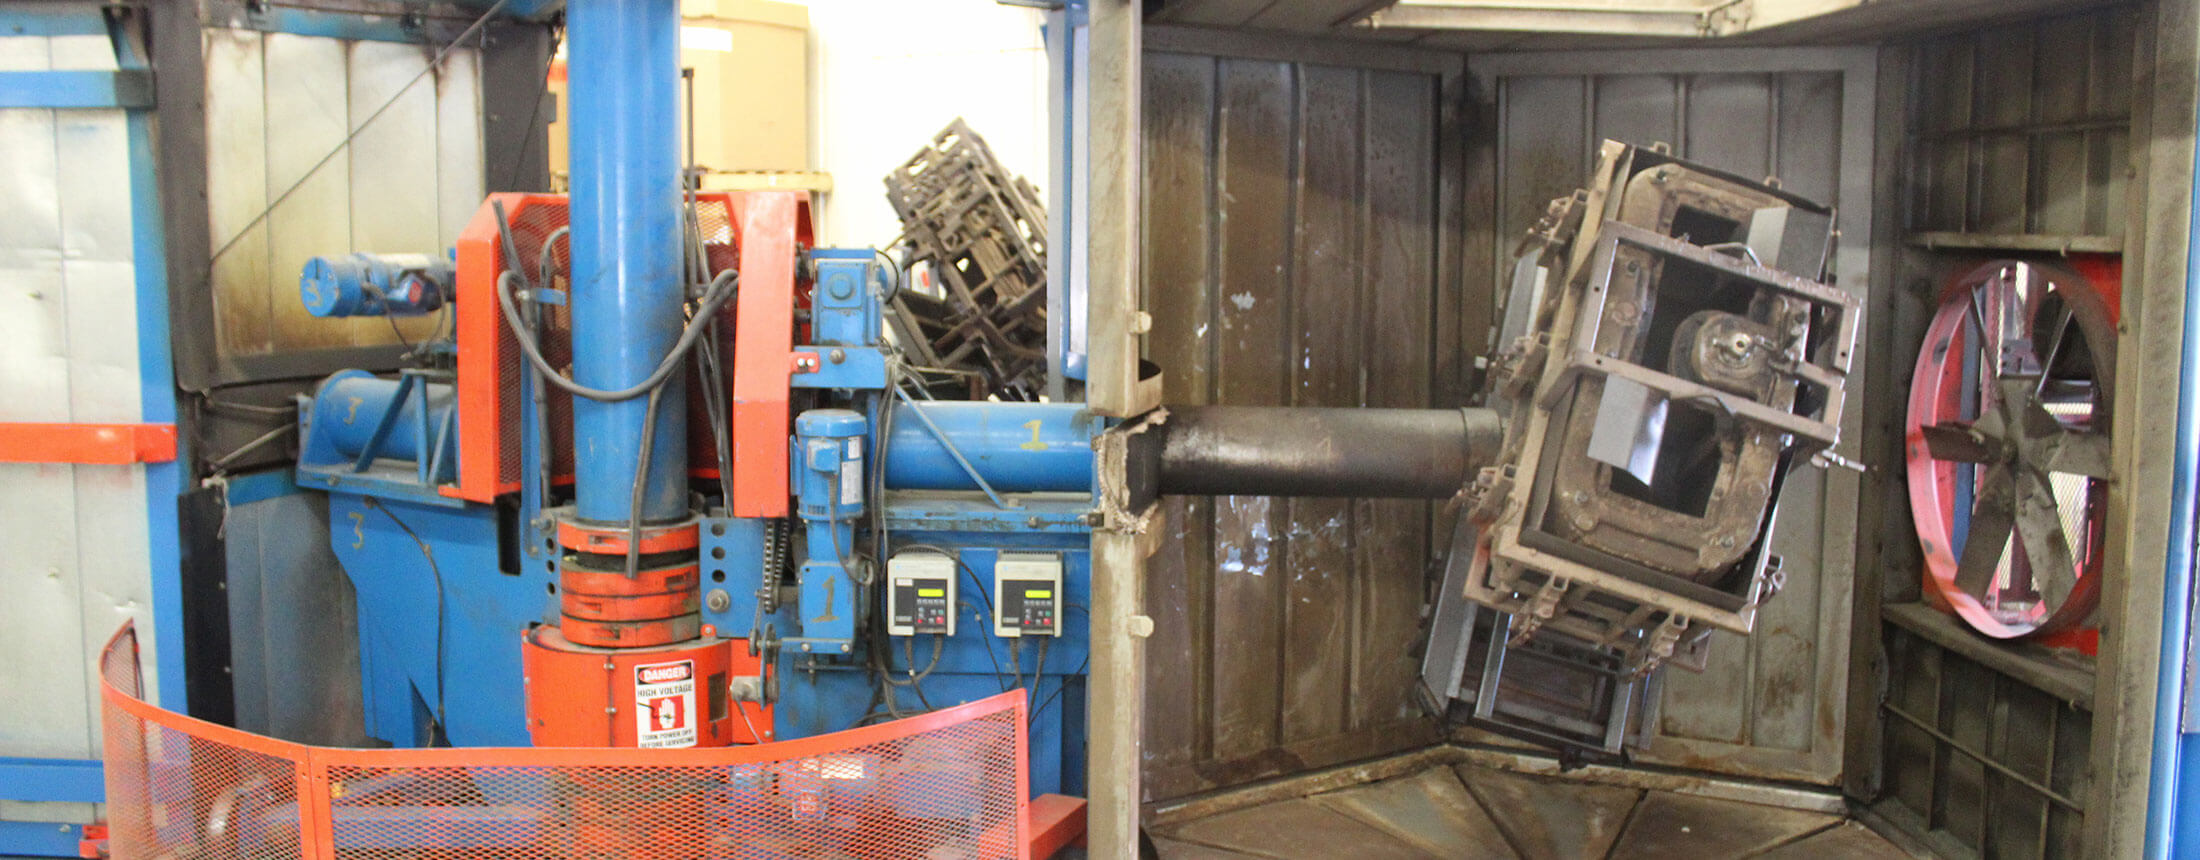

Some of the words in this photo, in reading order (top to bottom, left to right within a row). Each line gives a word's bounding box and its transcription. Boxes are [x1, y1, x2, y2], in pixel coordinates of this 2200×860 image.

[1020, 419, 1048, 452] 1
[348, 511, 364, 550] 3
[811, 575, 840, 623] 1
[644, 667, 686, 681] DANGER
[638, 689, 657, 697] HIGH
[660, 684, 692, 695] VOLTAGE
[660, 731, 681, 739] POWER
